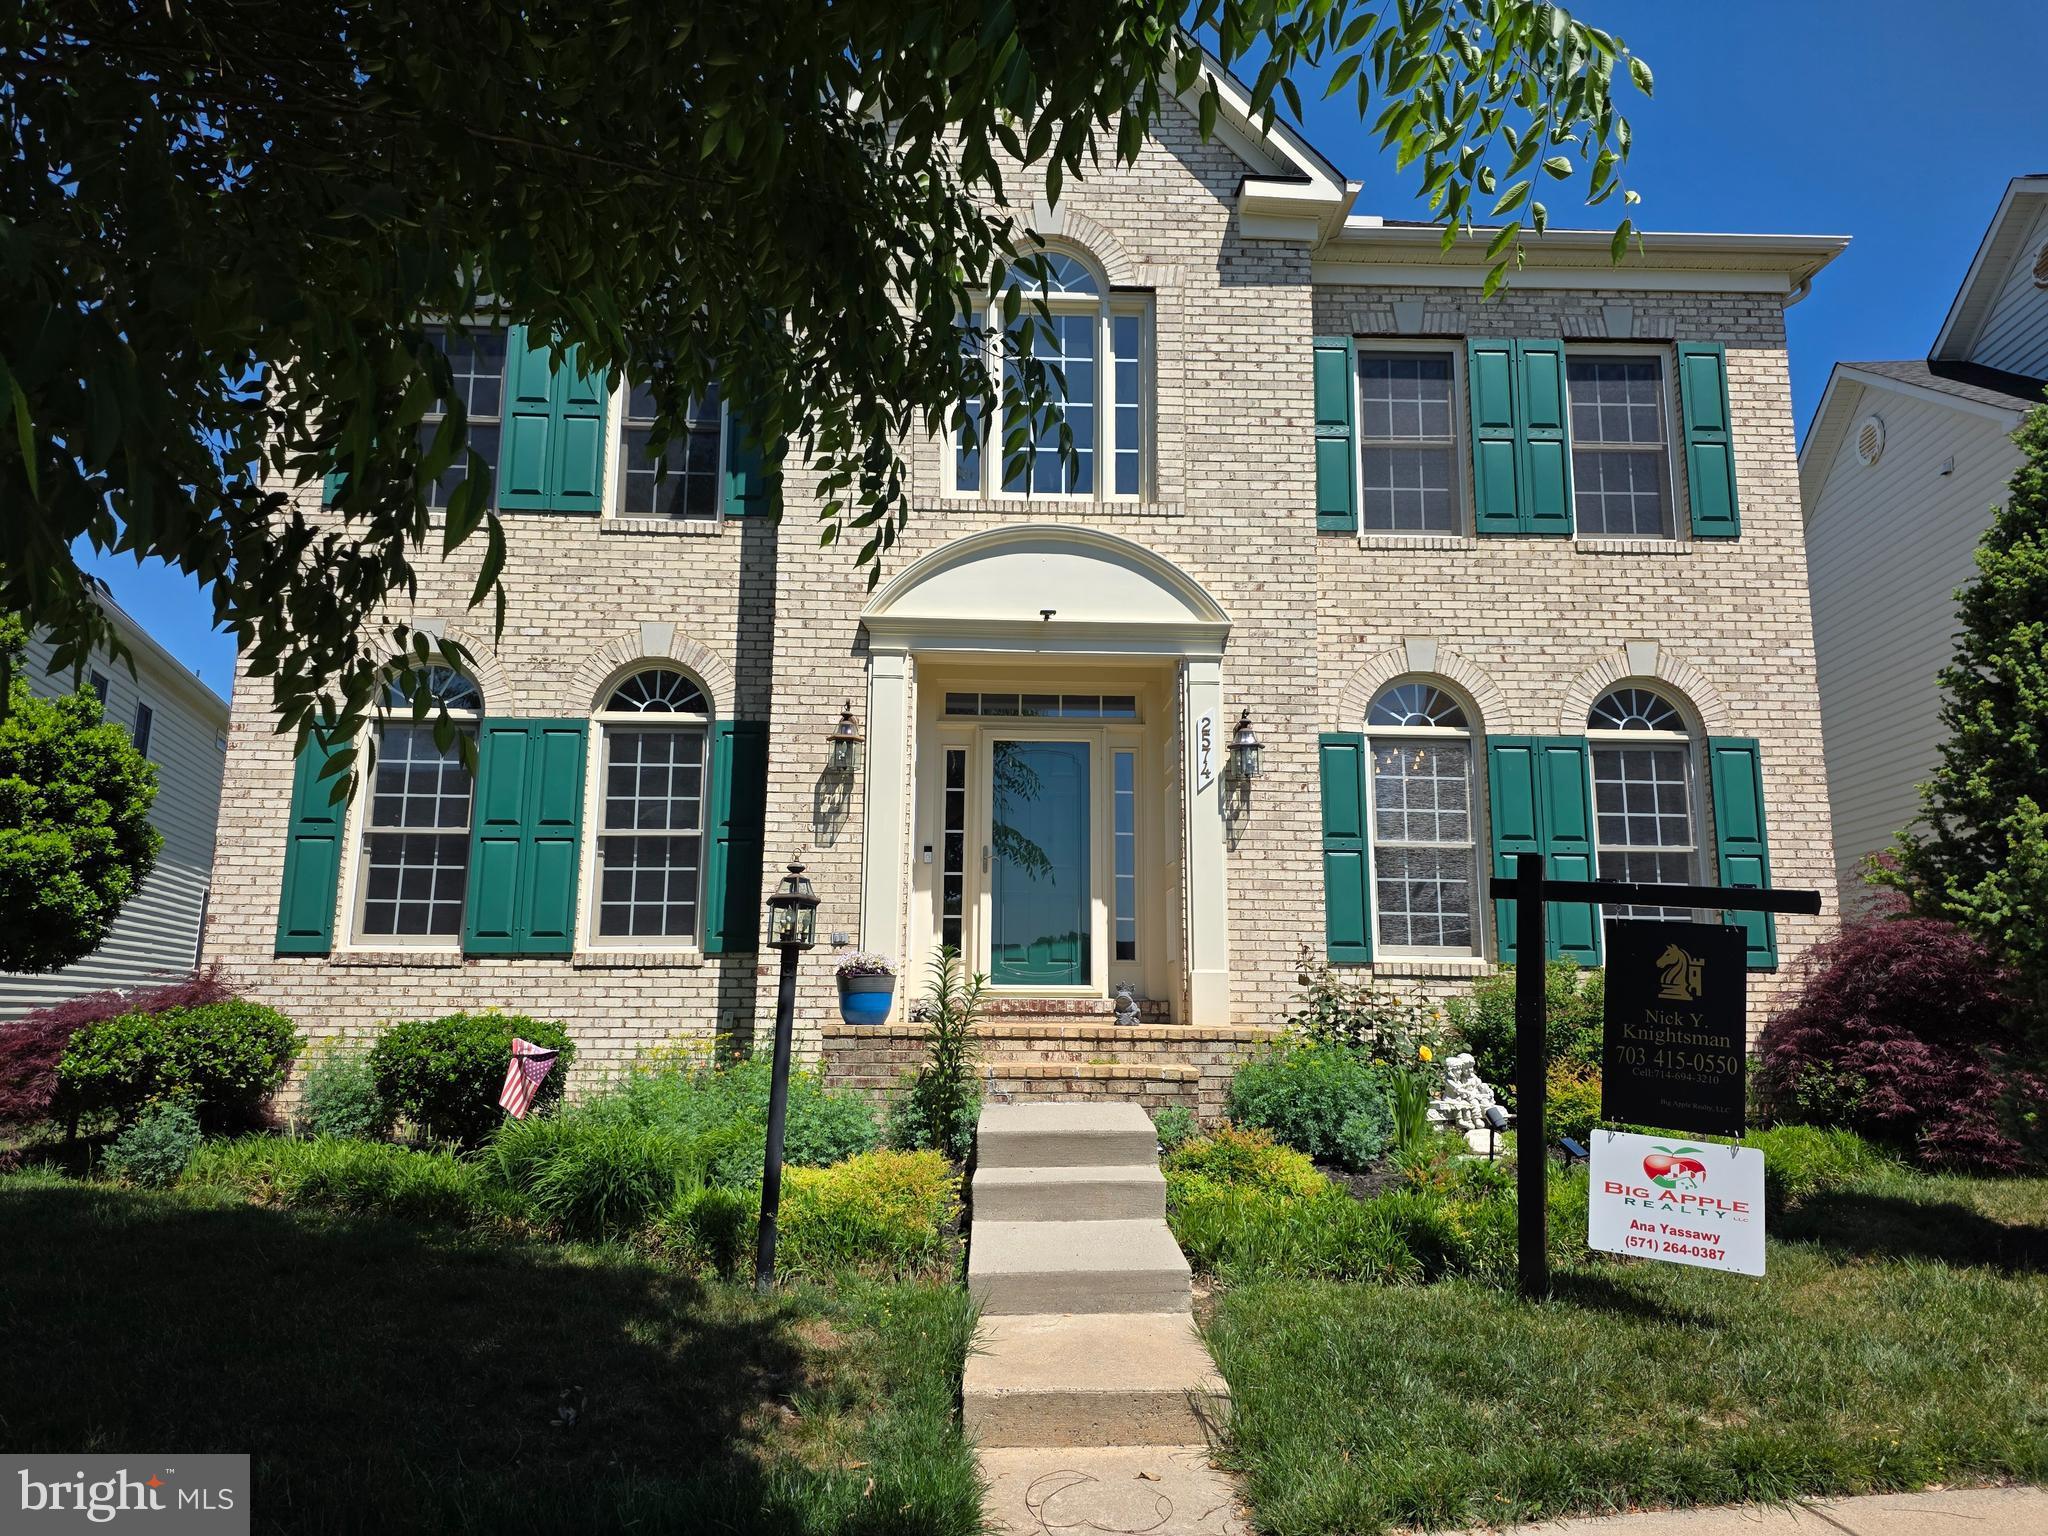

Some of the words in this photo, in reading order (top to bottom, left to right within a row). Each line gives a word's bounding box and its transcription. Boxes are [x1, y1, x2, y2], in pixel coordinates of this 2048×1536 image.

[1200, 717, 1211, 779] 2574
[1645, 1009, 1683, 1026] Nick
[1690, 1013, 1708, 1029] Y.
[1623, 1023, 1731, 1048] Knightsman
[1616, 1046, 1646, 1066] 703
[1653, 1051, 1738, 1076] 415-0550
[1624, 1197, 1727, 1219] REALTY
[1630, 1219, 1656, 1233] Ana
[1659, 1223, 1721, 1245] Yassawy
[1625, 1235, 1659, 1253] (571)
[1663, 1241, 1726, 1261] 264-0387
